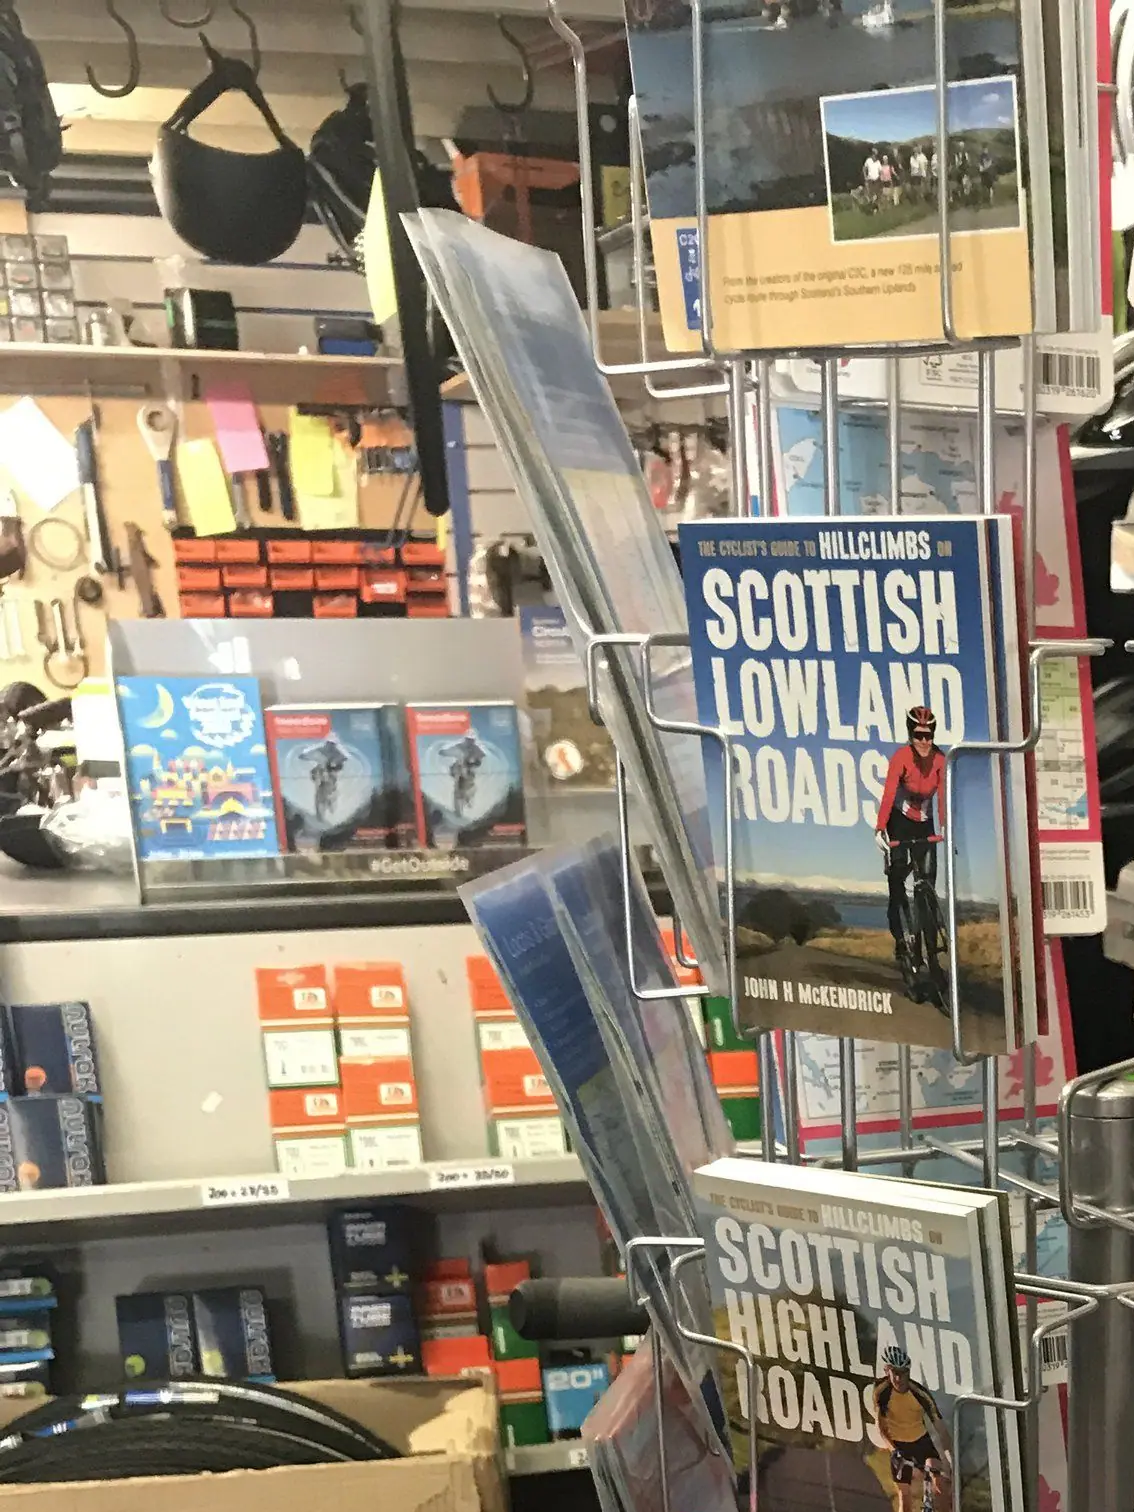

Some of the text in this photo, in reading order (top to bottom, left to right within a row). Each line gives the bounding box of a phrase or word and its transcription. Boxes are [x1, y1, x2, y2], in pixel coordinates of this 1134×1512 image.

[697, 540, 717, 557] THE
[803, 540, 816, 557] TO
[818, 530, 931, 561] HILLCLIMBS
[936, 540, 953, 557] ON
[702, 568, 960, 655] SCOTTISH
[711, 656, 966, 746] LOWLAND
[731, 745, 893, 828] ROADS
[744, 976, 893, 1016] JOHN H McKENDRICK
[62, 1002, 98, 1094] nutrak
[821, 1203, 924, 1244] HILLCLIMBS
[714, 1216, 952, 1323] SCOTTISH
[724, 1288, 974, 1398] HIGHLAND
[735, 1357, 894, 1450] ROADS
